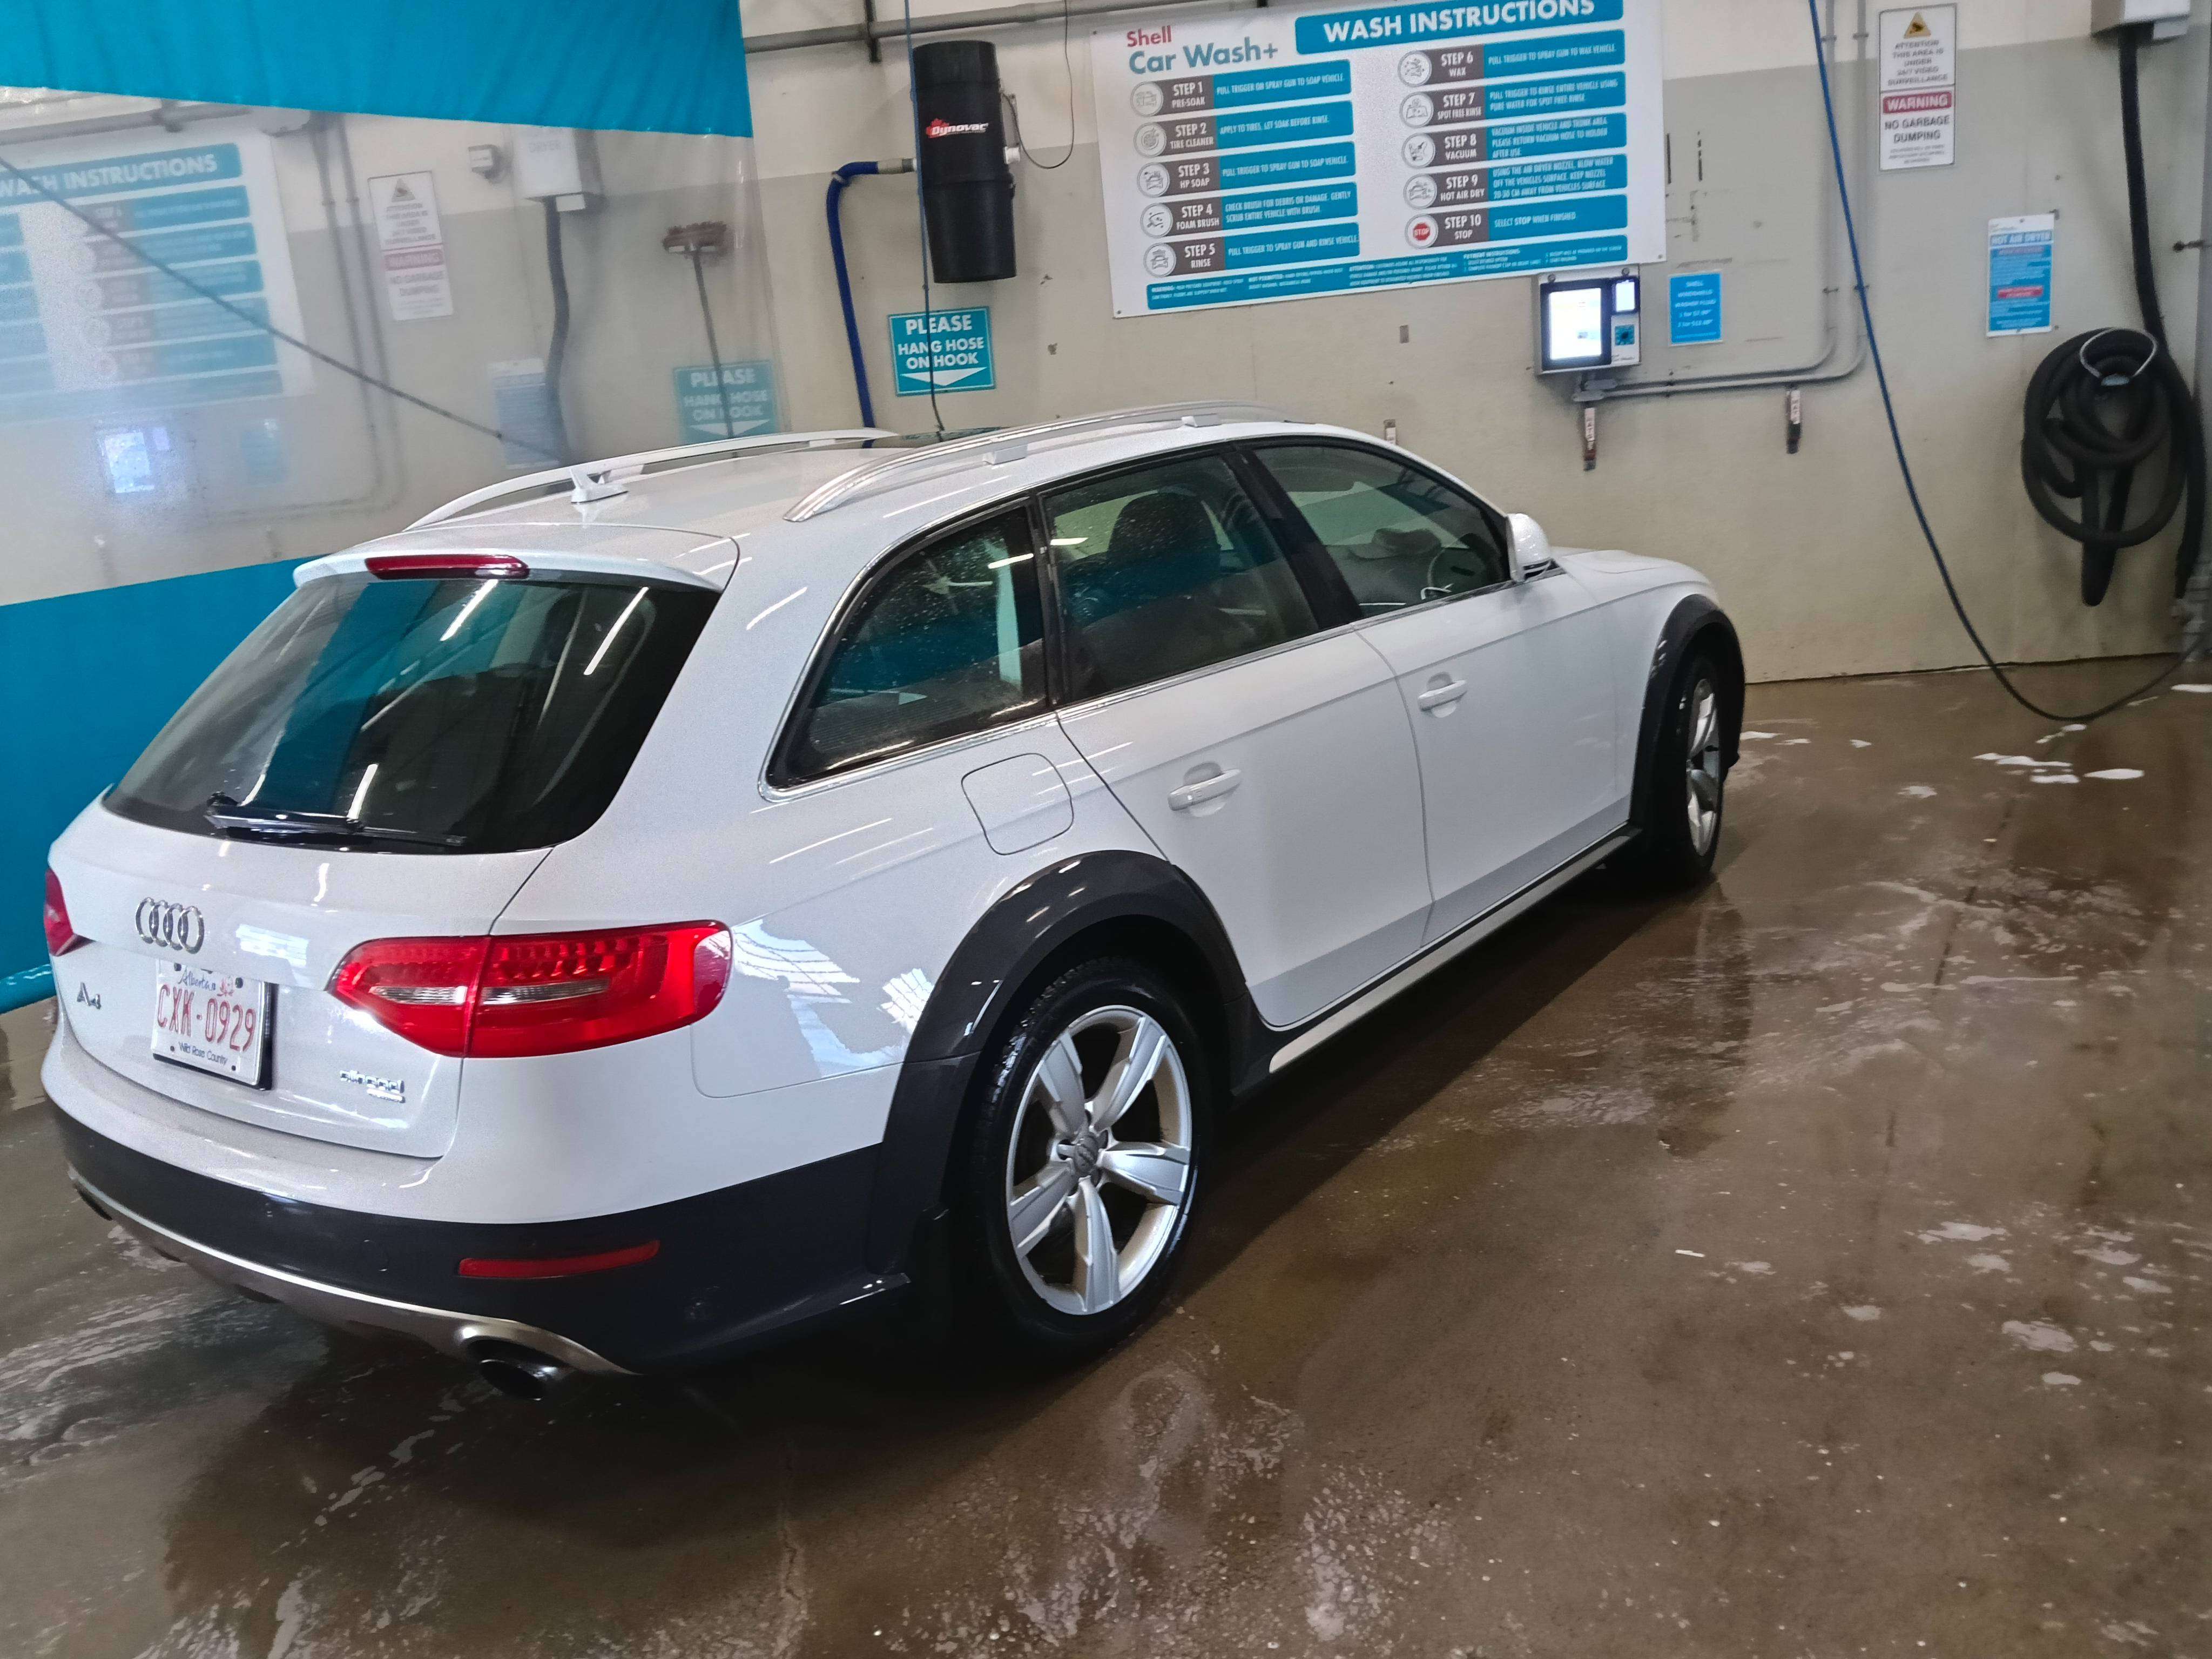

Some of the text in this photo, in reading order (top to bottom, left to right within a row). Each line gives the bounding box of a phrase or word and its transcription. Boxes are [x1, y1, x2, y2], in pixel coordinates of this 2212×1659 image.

[1323, 0, 1595, 43] WASH INSTRUCTIONS
[1127, 25, 1172, 48] Shell
[1129, 36, 1278, 75] Car Wash+
[1440, 50, 1474, 66] STEP 6
[1448, 66, 1466, 77] WAX
[1172, 80, 1203, 97] STEP 1
[1171, 96, 1205, 109] PRE-SOAK
[1442, 91, 1475, 108] STEP 7
[1887, 94, 1948, 112] WARNING
[1437, 106, 1481, 120] SPOT FREE RINSE
[932, 122, 989, 136] Dynovac
[1175, 121, 1207, 137] STEP 2
[1885, 115, 1950, 130] NO GARBAGE
[1169, 136, 1214, 150] TIRE CLEANER
[1444, 133, 1477, 149] STEP 8
[1894, 130, 1940, 144] DUMPING
[1445, 148, 1477, 161] VACUUM
[64, 153, 217, 190] INSTRUCTIONS
[1177, 161, 1210, 178] STEP 3
[1179, 176, 1211, 189] HP SOAP
[1445, 173, 1478, 190] STEP 9
[1440, 187, 1485, 201] HOT AIR DRY
[1181, 203, 1213, 218] STEP 4
[1176, 217, 1220, 231] FOAM BRUSH
[1444, 213, 1482, 230] STEP 10
[1513, 215, 1532, 226] STOP
[1413, 226, 1430, 237] STOP
[1454, 228, 1473, 240] STOP
[1184, 242, 1216, 258] STEP 5
[1190, 257, 1211, 268] RINSE
[906, 314, 973, 335] PLEASE
[898, 337, 984, 355] HANG HOSE
[906, 352, 979, 369] ON HOOK
[77, 981, 102, 1010] A4
[157, 983, 257, 1053] CXK-0929
[178, 1041, 228, 1065] Wild Rose Country
